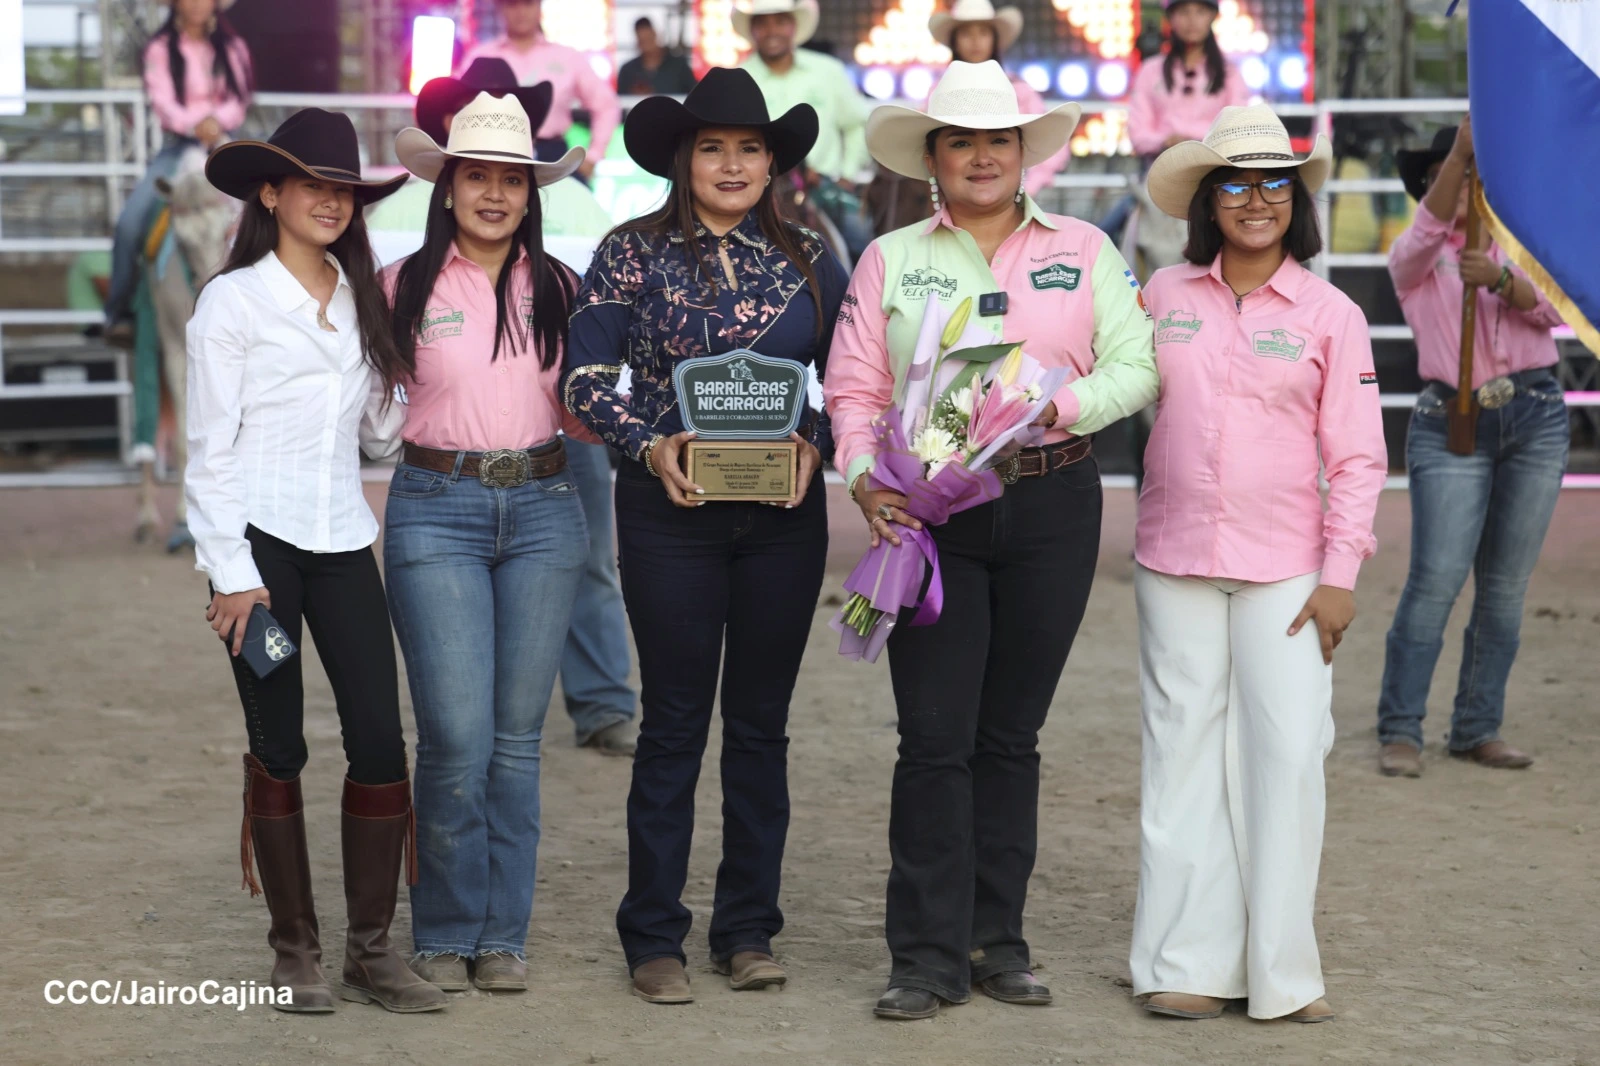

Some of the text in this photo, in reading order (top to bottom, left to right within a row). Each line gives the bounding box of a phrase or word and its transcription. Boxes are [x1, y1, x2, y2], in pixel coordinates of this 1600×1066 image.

[432, 324, 462, 337] Corral
[1166, 330, 1197, 340] Corral
[694, 381, 789, 395] BARRILERAS
[698, 396, 785, 411] NICARAGUA
